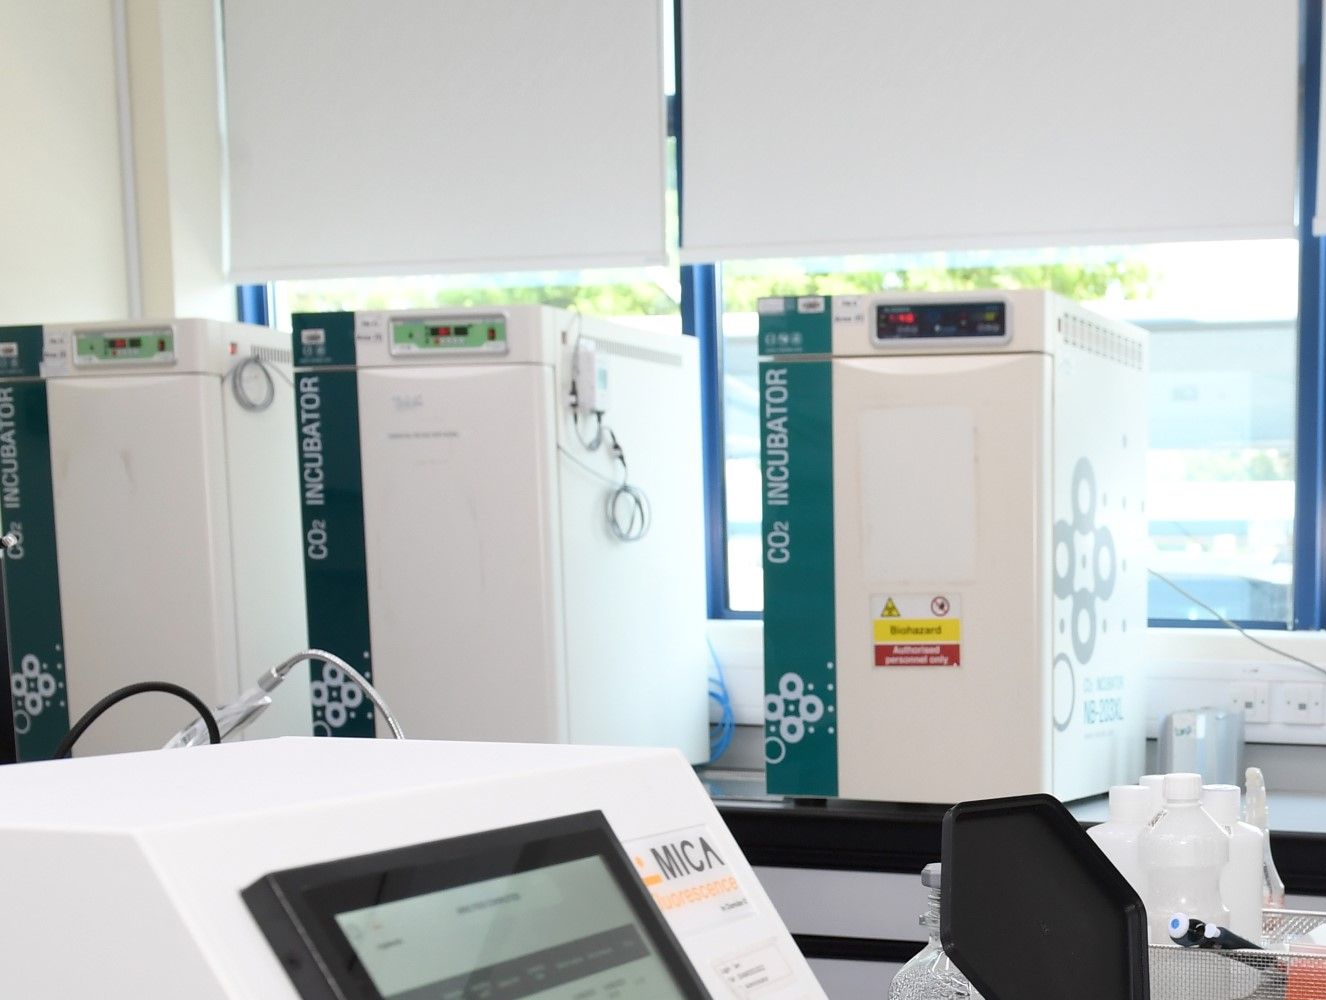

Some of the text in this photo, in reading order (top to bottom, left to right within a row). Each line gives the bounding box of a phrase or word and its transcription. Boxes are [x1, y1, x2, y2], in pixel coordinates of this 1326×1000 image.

[300, 376, 325, 505] INCUBATOR
[765, 368, 790, 564] CO2 INCUBATOR
[308, 519, 328, 560] CO2
[890, 625, 942, 636] Biohazard
